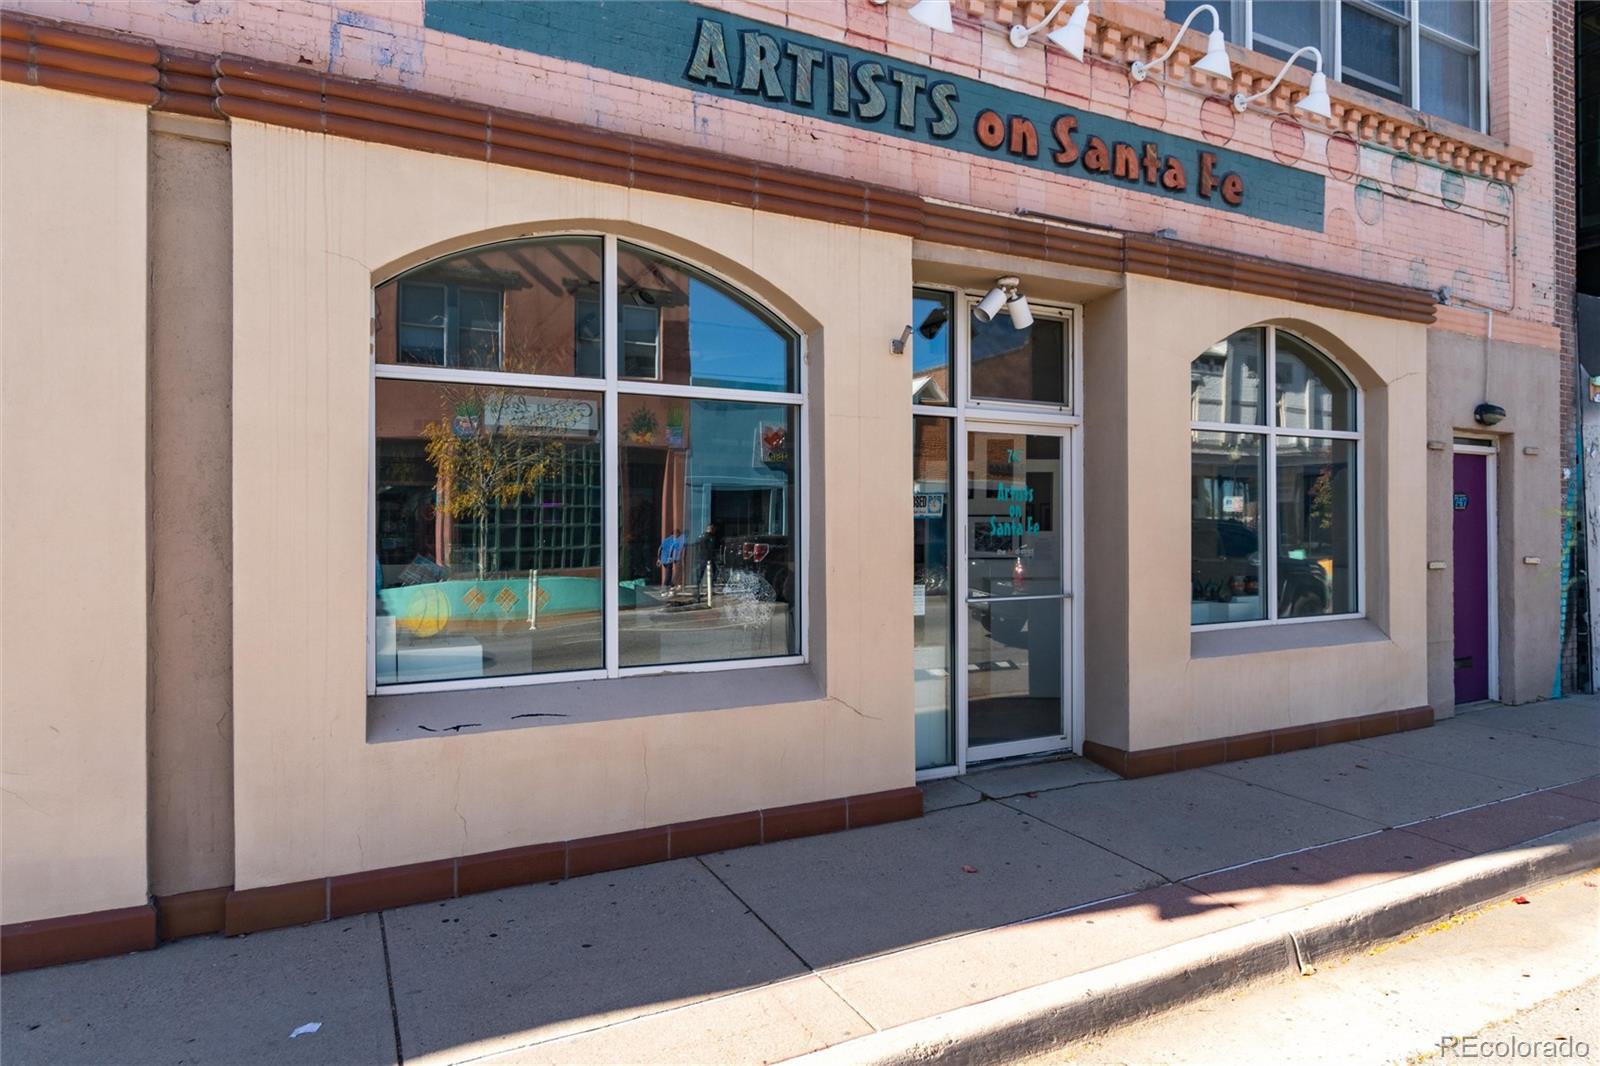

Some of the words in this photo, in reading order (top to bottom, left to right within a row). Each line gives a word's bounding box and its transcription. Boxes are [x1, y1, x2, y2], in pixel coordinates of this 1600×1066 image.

[687, 18, 960, 138] ARTISTS
[975, 108, 1039, 158] on
[1052, 114, 1188, 192] Santa
[1200, 151, 1245, 206] Fe
[1009, 505, 1022, 516] on
[989, 516, 1024, 535] Santa
[1026, 516, 1040, 536] Fe
